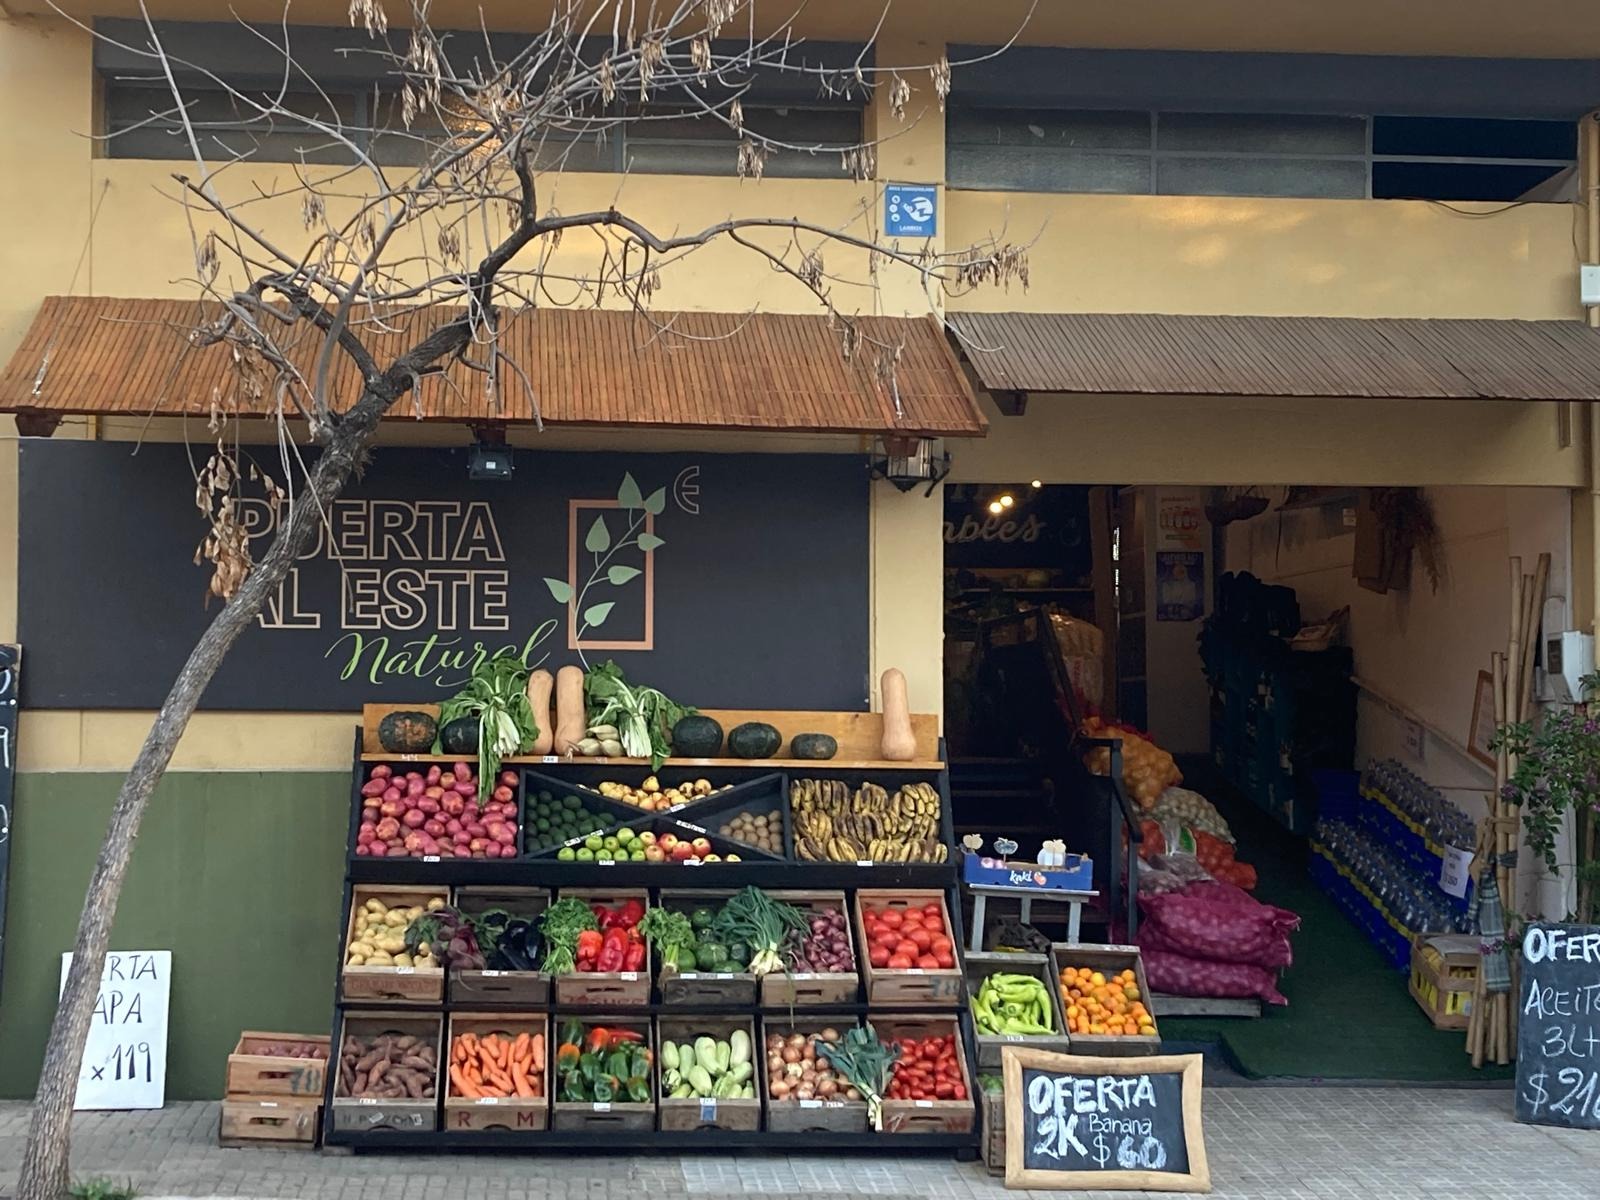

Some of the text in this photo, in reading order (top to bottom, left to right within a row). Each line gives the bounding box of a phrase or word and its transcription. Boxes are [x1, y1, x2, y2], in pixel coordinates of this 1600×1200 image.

[341, 568, 510, 631] ESTE
[1028, 1075, 1157, 1115] OFERTA
[1033, 1113, 1153, 1160] 2K Banana
